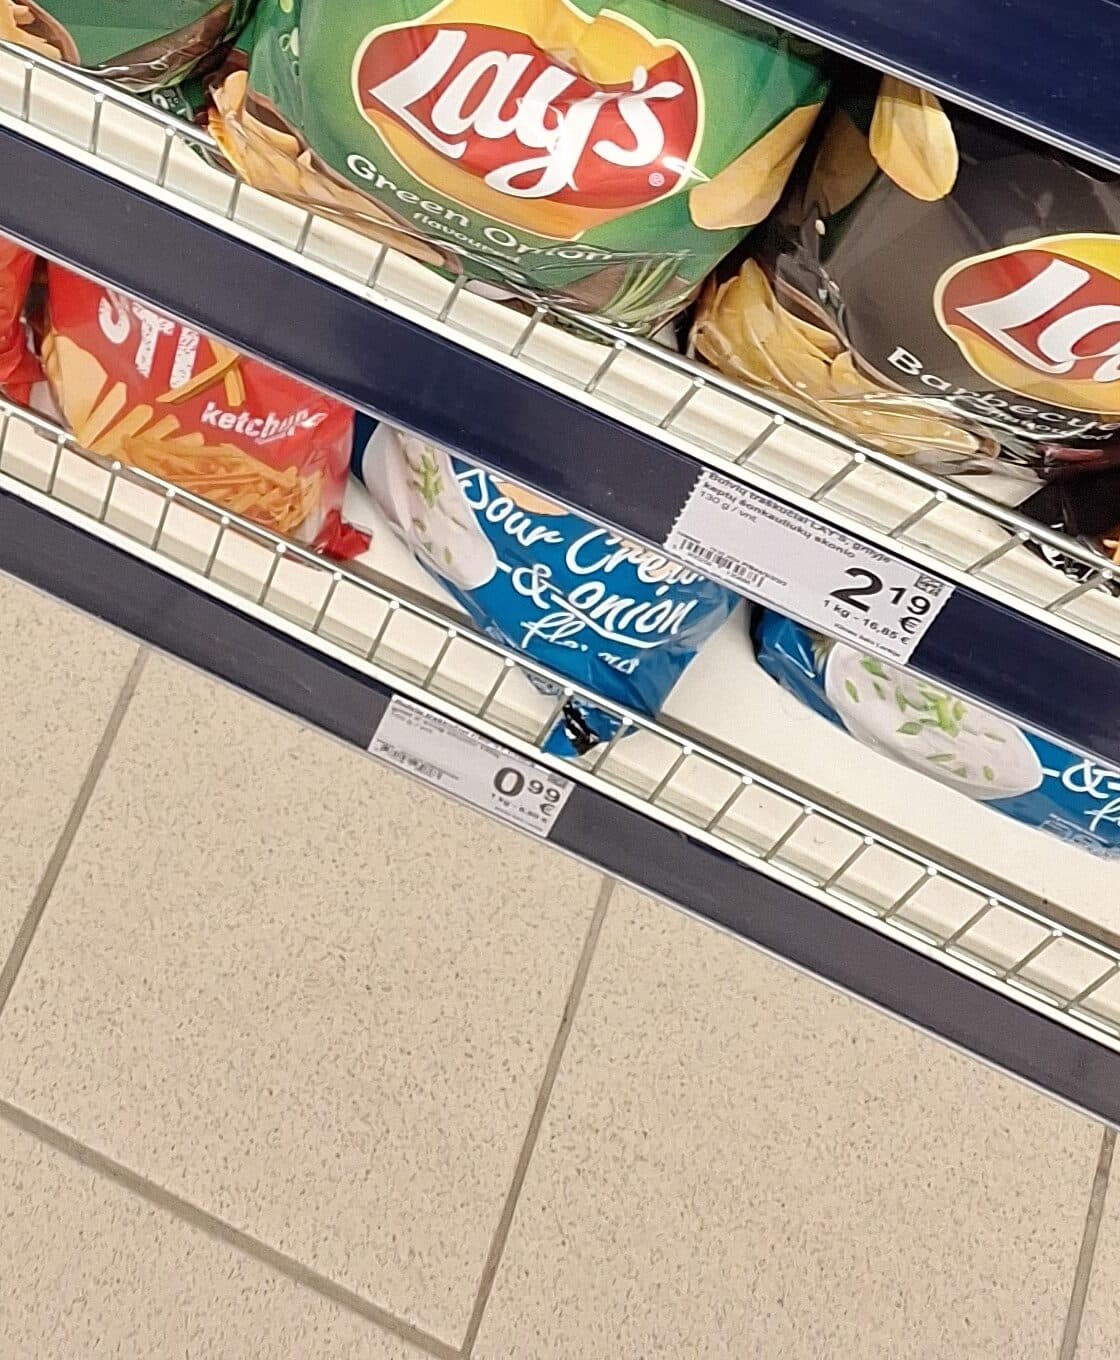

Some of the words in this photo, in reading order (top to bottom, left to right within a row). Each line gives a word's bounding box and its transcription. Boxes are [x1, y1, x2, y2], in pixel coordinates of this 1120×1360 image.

[368, 29, 684, 198] Lay's
[345, 153, 471, 228] Green
[458, 466, 565, 547] Sour
[813, 534, 855, 558] skonio
[512, 562, 551, 610] &
[568, 580, 698, 637] onion
[832, 603, 851, 619] kg
